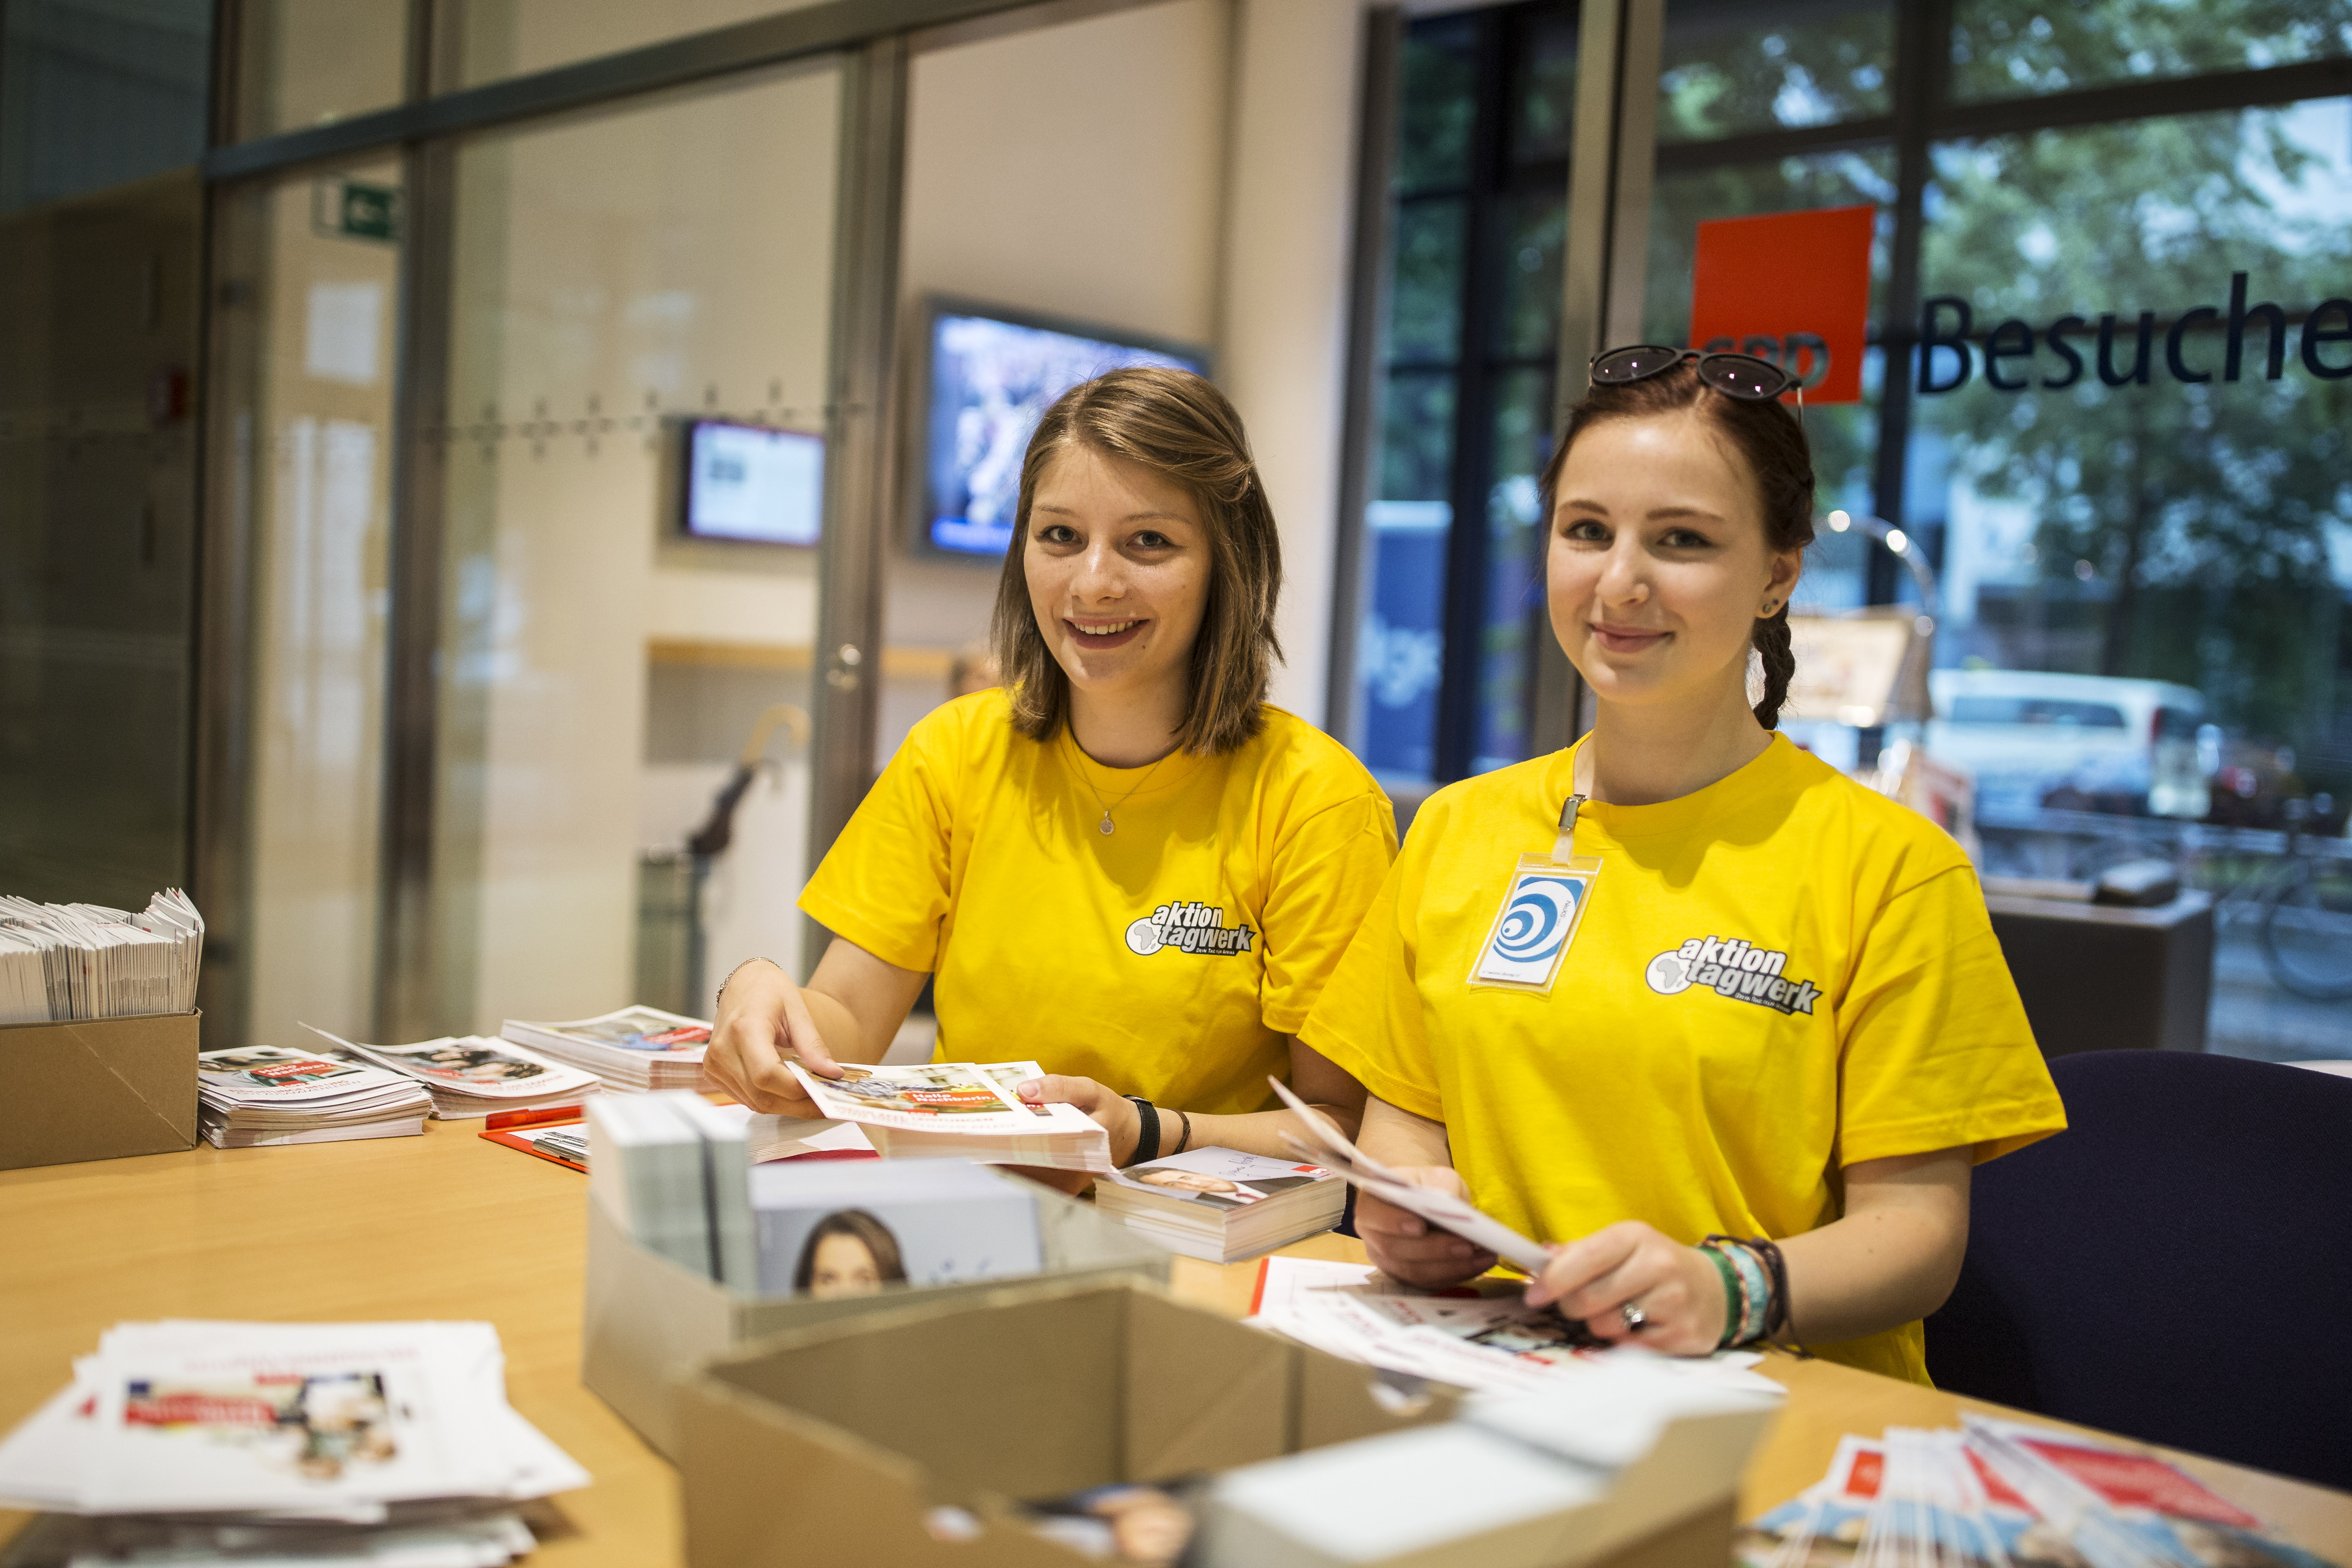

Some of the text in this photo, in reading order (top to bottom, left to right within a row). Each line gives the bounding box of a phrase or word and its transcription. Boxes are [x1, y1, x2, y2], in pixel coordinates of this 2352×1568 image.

[1917, 271, 2352, 395] Besuche
[1152, 901, 1223, 928] aktion
[1159, 924, 1254, 954] tagwerk
[1678, 936, 1787, 976] aktion
[1687, 960, 1822, 1014] tagwerk
